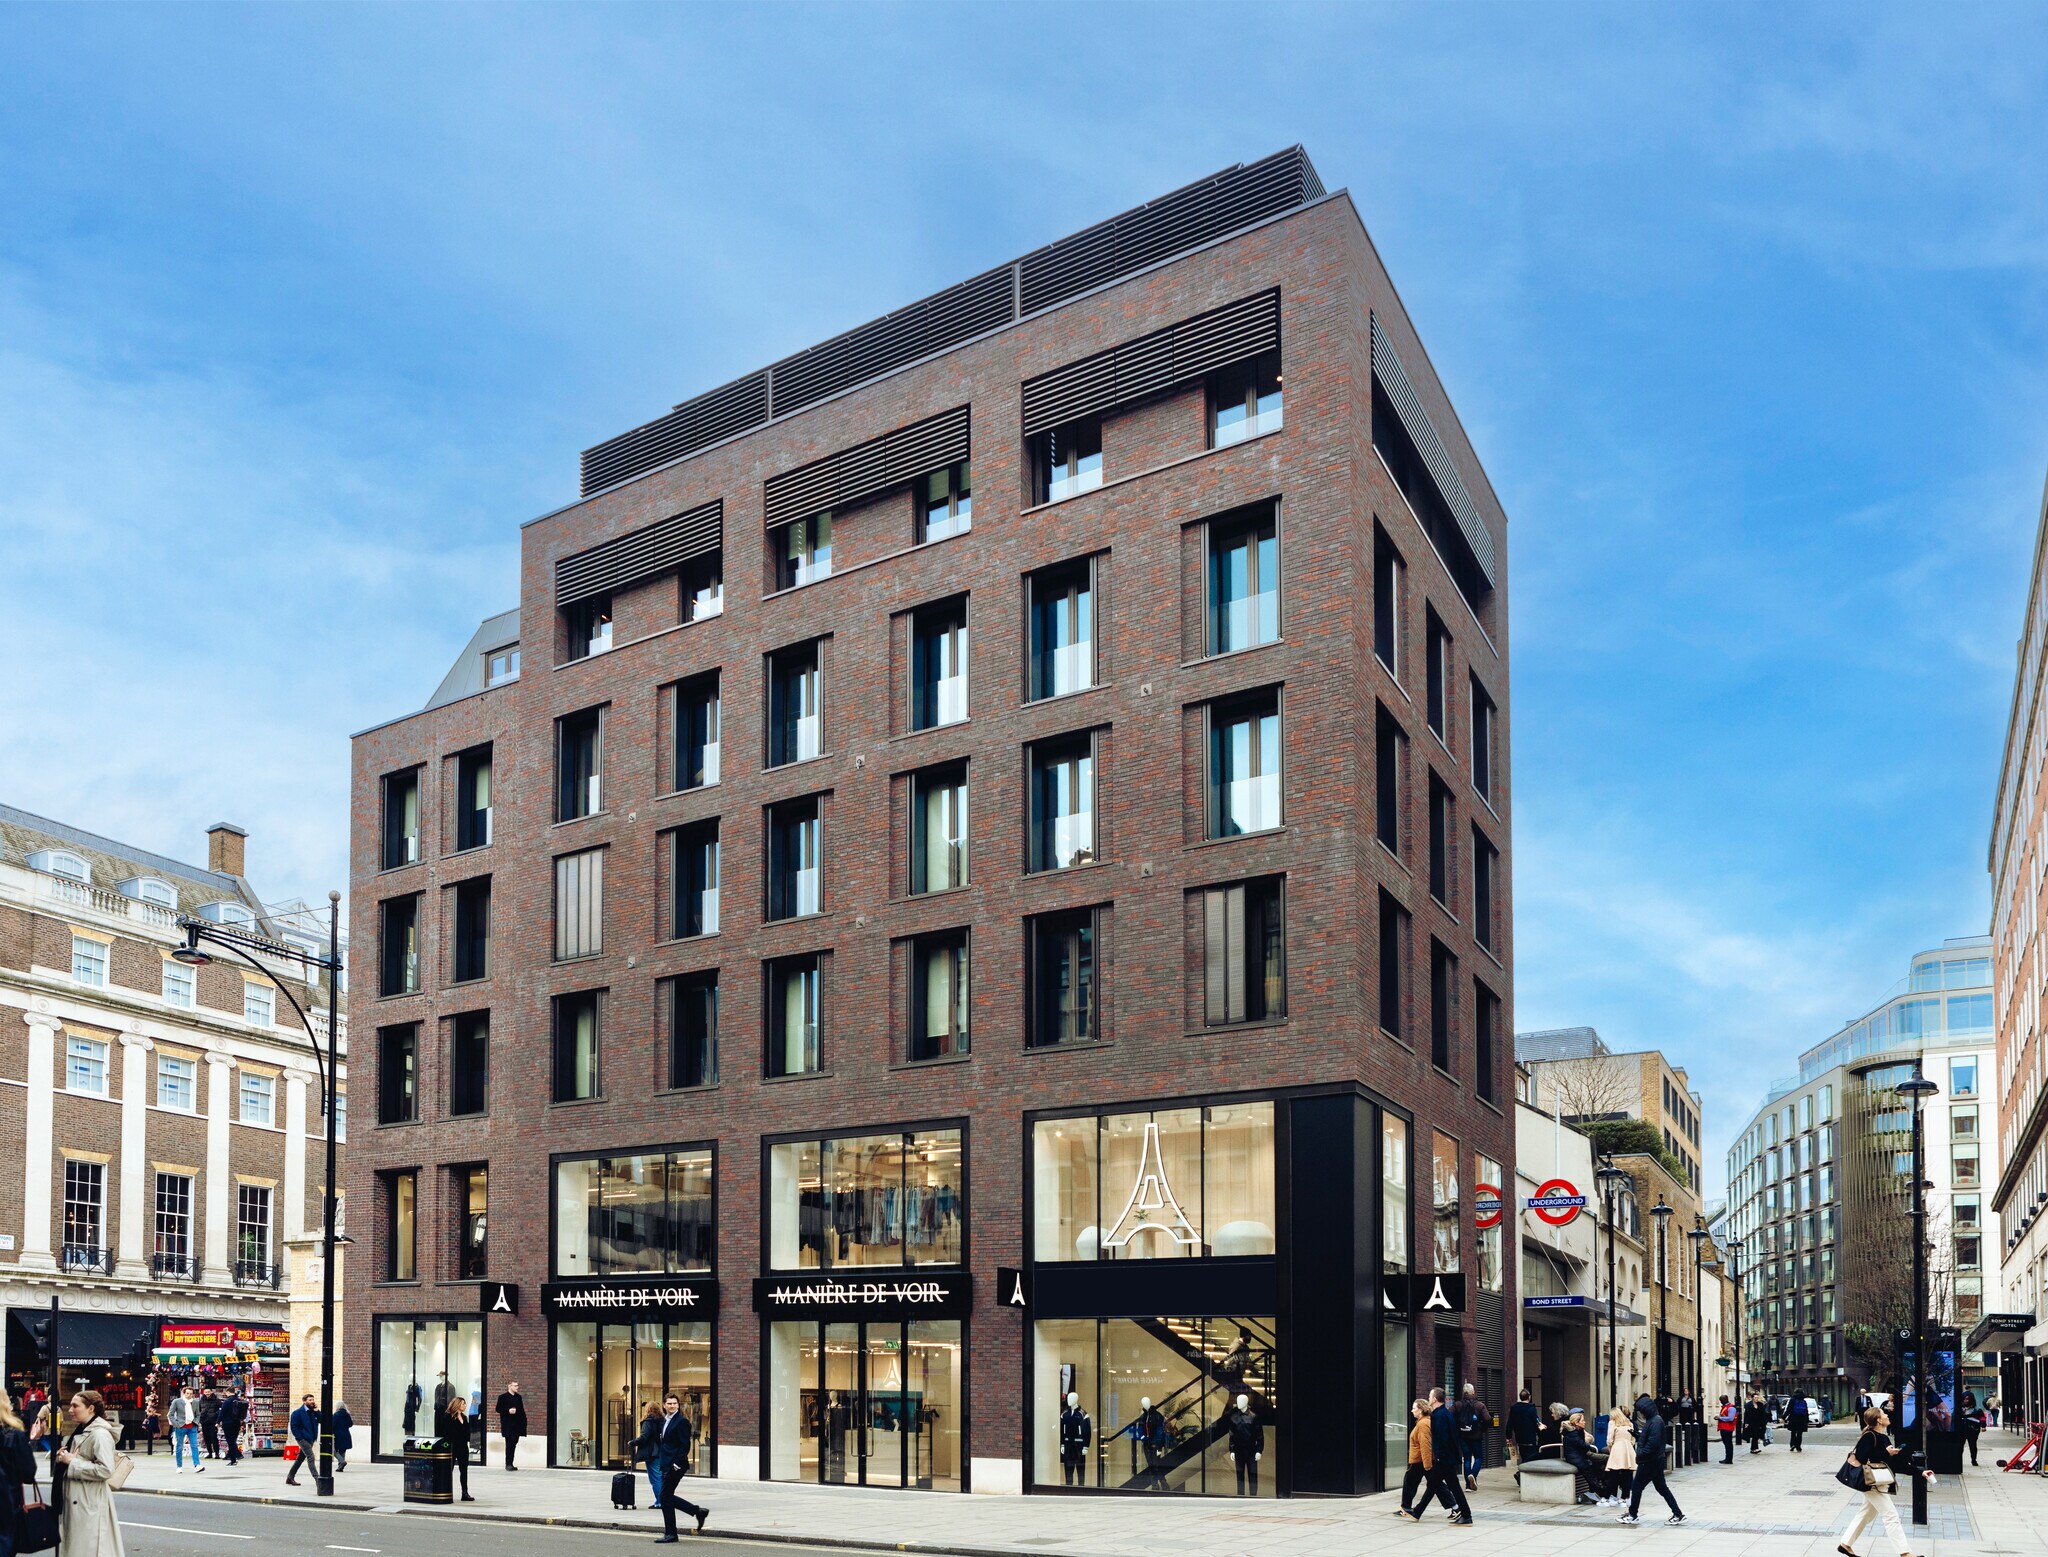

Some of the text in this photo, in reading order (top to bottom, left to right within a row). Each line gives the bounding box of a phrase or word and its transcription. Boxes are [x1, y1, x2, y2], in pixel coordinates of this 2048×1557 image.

[1530, 1197, 1584, 1206] UNDERGROUND
[559, 1284, 695, 1307] MANIÈRE DE VOIR
[775, 1278, 944, 1304] MANIÈRE DE VOIR
[174, 1335, 183, 1343] BUY
[184, 1335, 204, 1343] TICKETS
[204, 1335, 217, 1343] HERE
